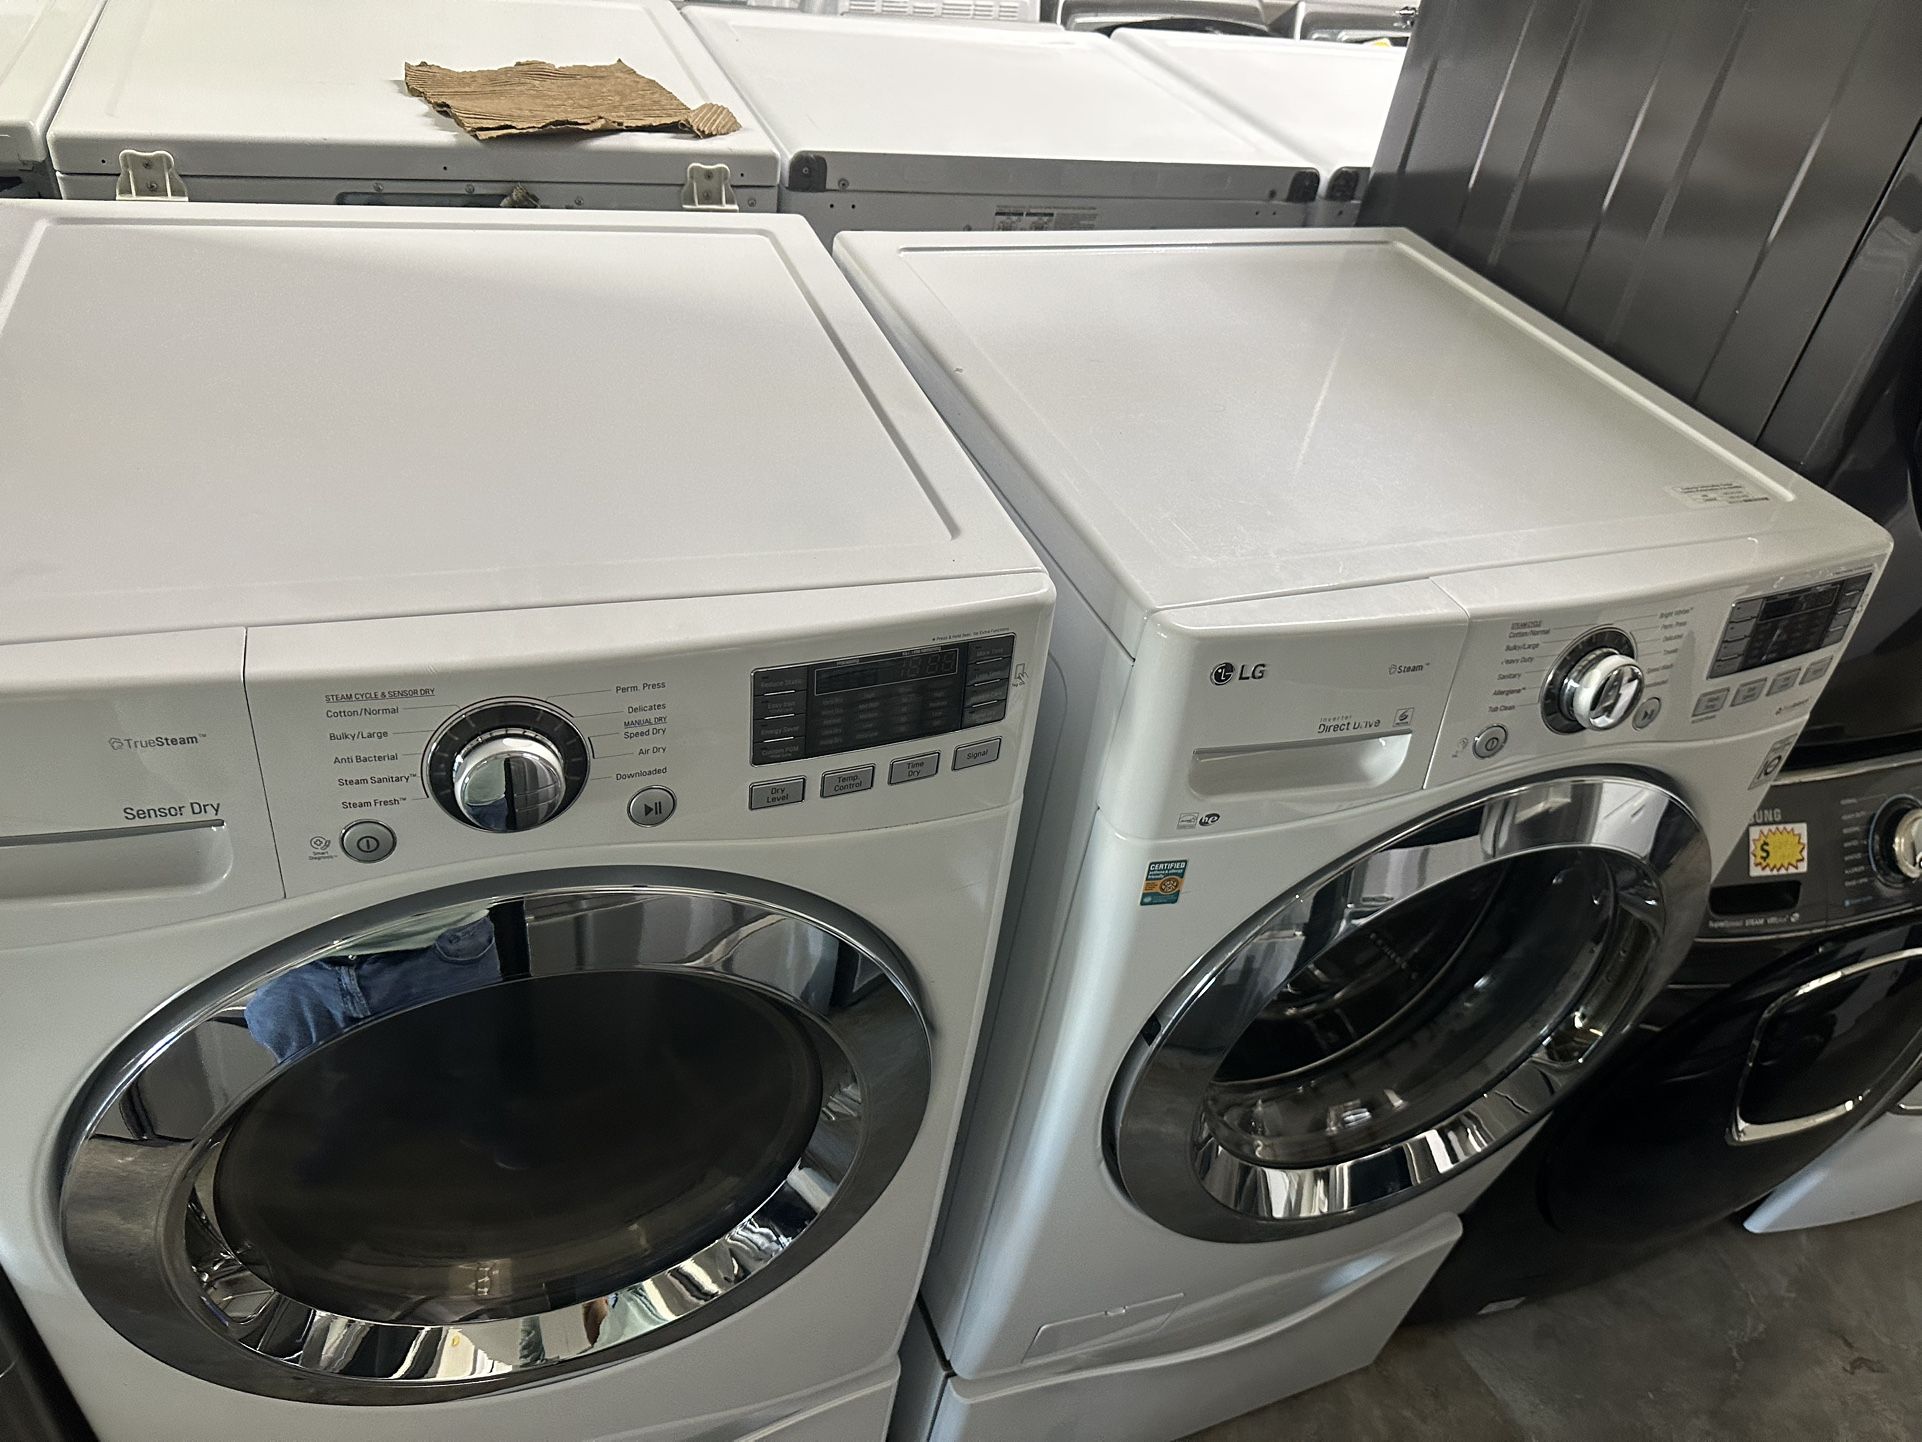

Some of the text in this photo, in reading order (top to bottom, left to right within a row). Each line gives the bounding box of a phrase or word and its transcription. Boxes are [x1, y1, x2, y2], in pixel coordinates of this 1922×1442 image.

[1238, 663, 1266, 681] LG
[642, 681, 667, 691] Press
[325, 687, 435, 703] STEAM CYCLE & SENSOR DRY
[326, 705, 400, 720] Cotton/Normal
[627, 702, 667, 715] Delicates
[623, 715, 668, 728] MANUAL DRY
[1317, 721, 1351, 734] Direct
[329, 729, 389, 743] Bulky/Large
[623, 726, 667, 741] Speed Dry
[638, 745, 667, 757] Air Dry
[966, 748, 989, 761] Signal
[333, 753, 399, 765] Anti Bacterial
[906, 760, 925, 770] Time
[615, 766, 668, 781] Downloaded
[907, 768, 922, 778] Dry
[338, 777, 368, 788] Steam
[837, 774, 861, 785] Temp.
[770, 786, 785, 797] Dry
[833, 780, 863, 792] Control
[766, 792, 789, 803] Level
[342, 799, 374, 809] Steam
[123, 800, 221, 822] Sensor Dry
[1760, 841, 1771, 863] $
[1150, 862, 1186, 871] CERTIFIED
